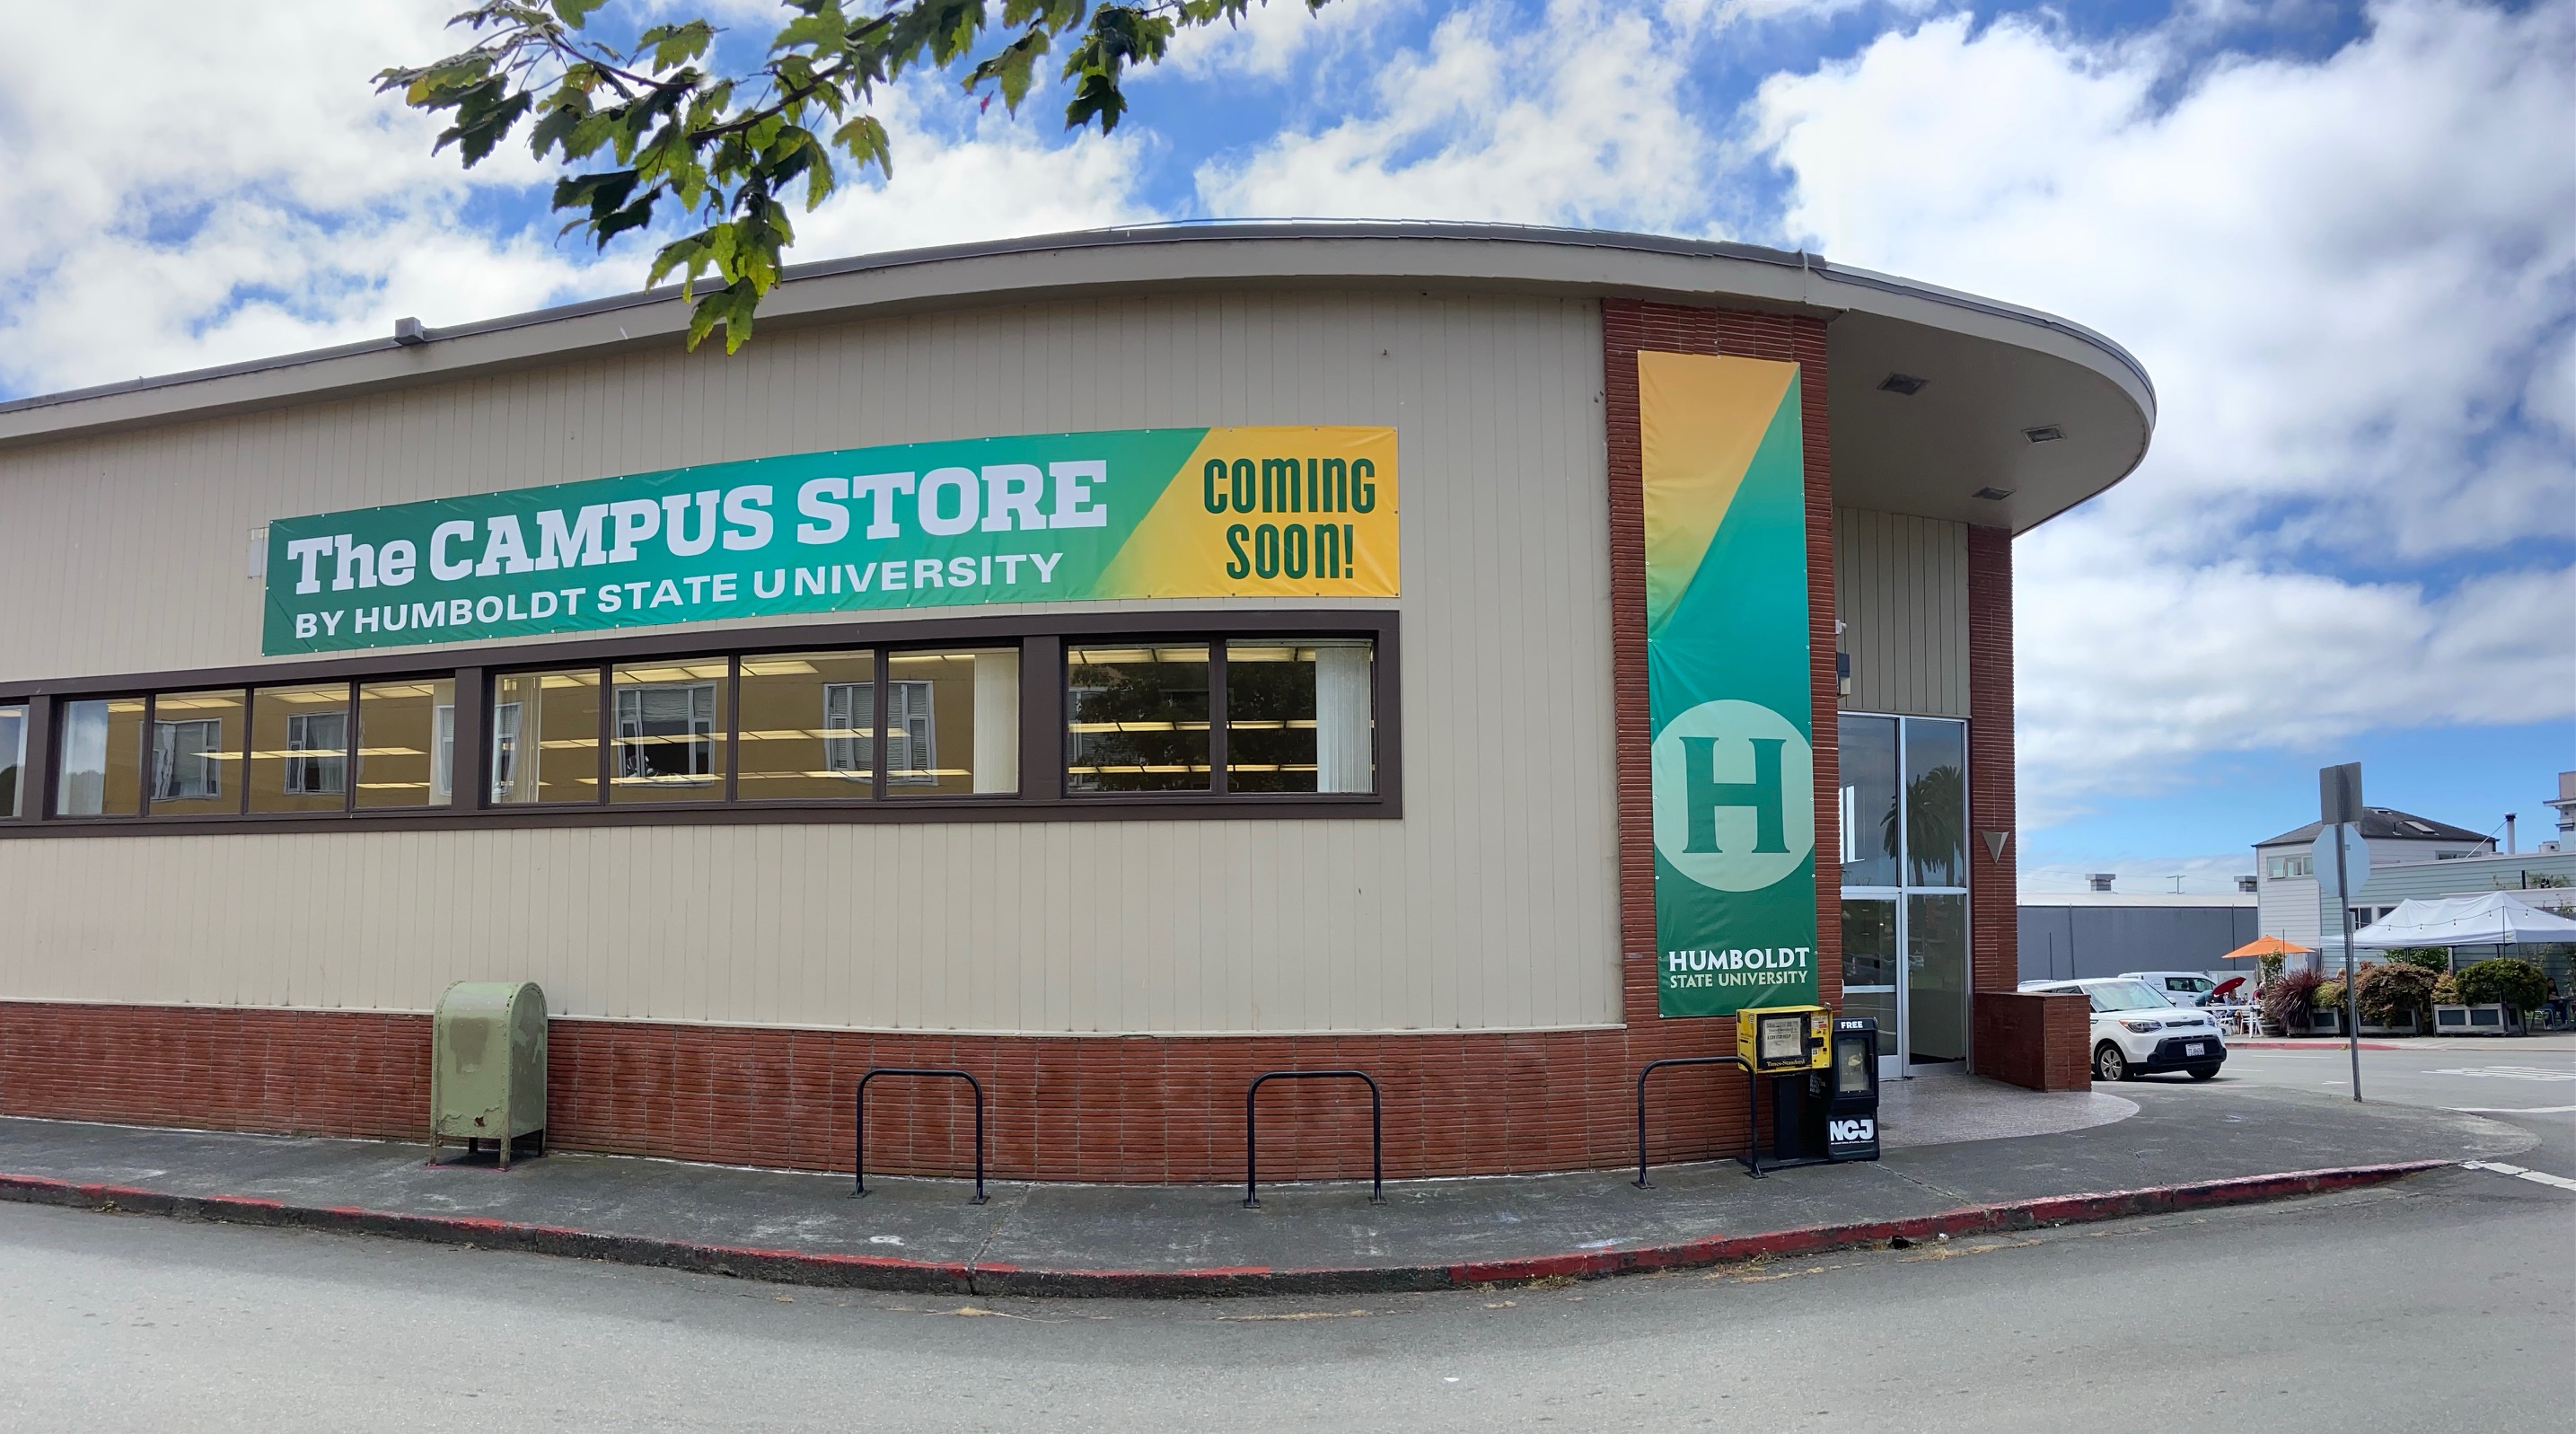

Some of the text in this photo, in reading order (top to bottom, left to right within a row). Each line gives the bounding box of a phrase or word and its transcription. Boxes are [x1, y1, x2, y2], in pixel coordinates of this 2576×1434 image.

[287, 460, 1108, 595] The CAMPUS STORE
[295, 552, 1064, 639] BY HUMBOLDT STATE UNIVERSITY
[1678, 736, 1791, 854] H
[1668, 946, 1810, 972] HUMBOLDT
[1670, 971, 1808, 989] STATE UNIVERSITY
[1841, 1021, 1863, 1029] FREE
[1830, 1119, 1874, 1141] NCJ
